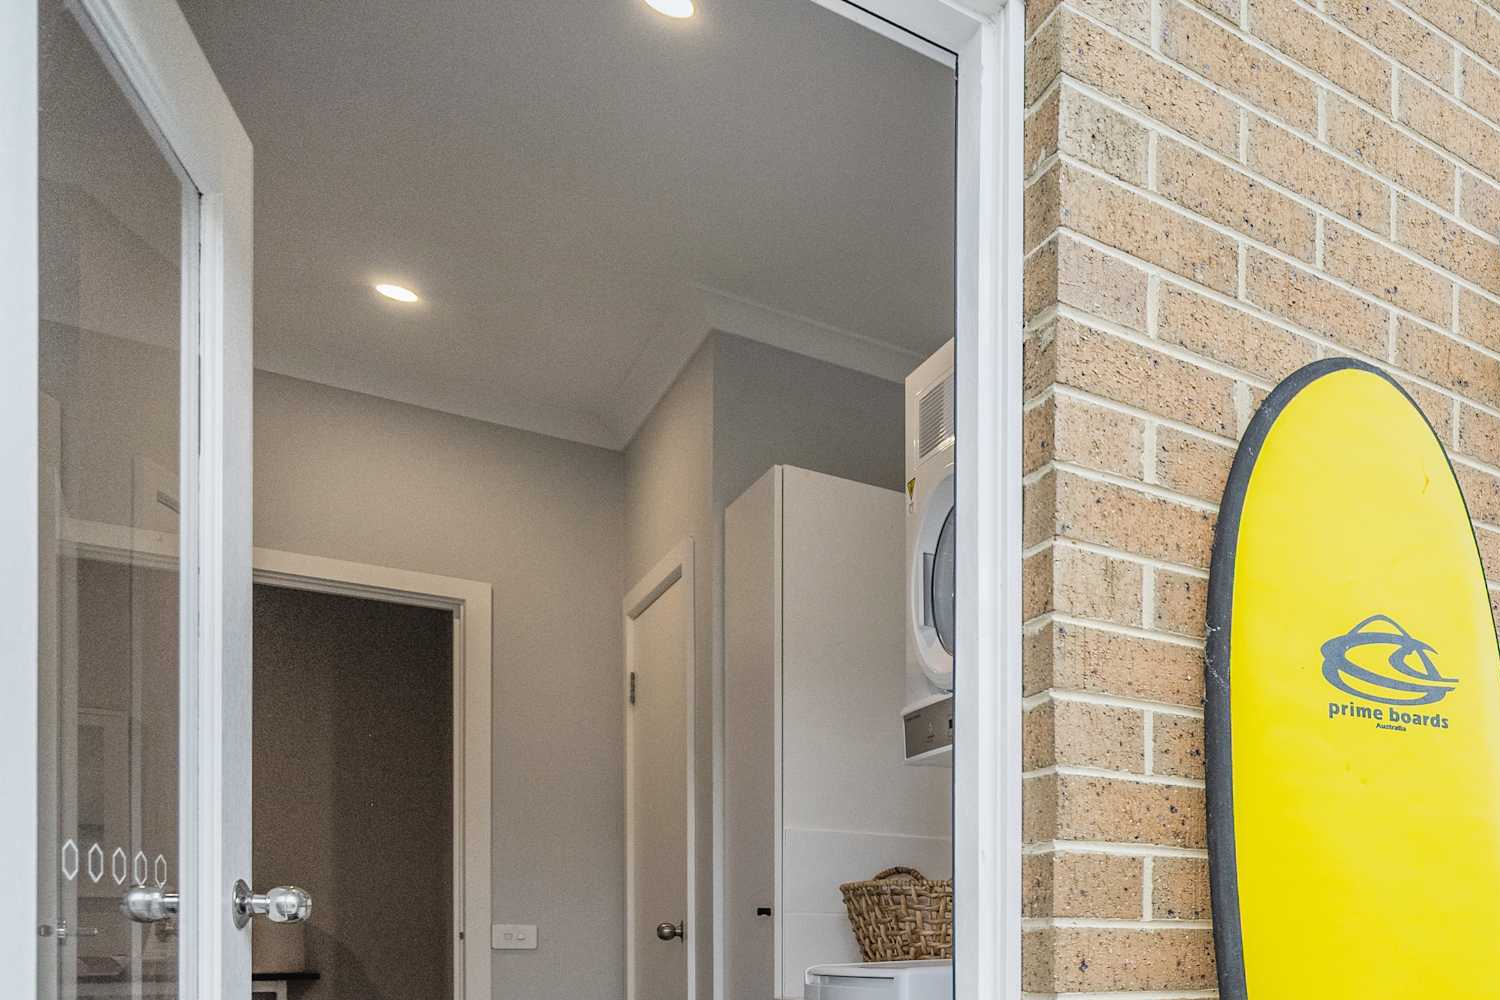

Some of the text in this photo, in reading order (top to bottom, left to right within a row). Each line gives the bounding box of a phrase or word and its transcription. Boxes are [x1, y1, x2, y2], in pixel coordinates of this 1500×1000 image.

[1328, 702, 1449, 729] prime boards
[1375, 723, 1407, 732] Australia
